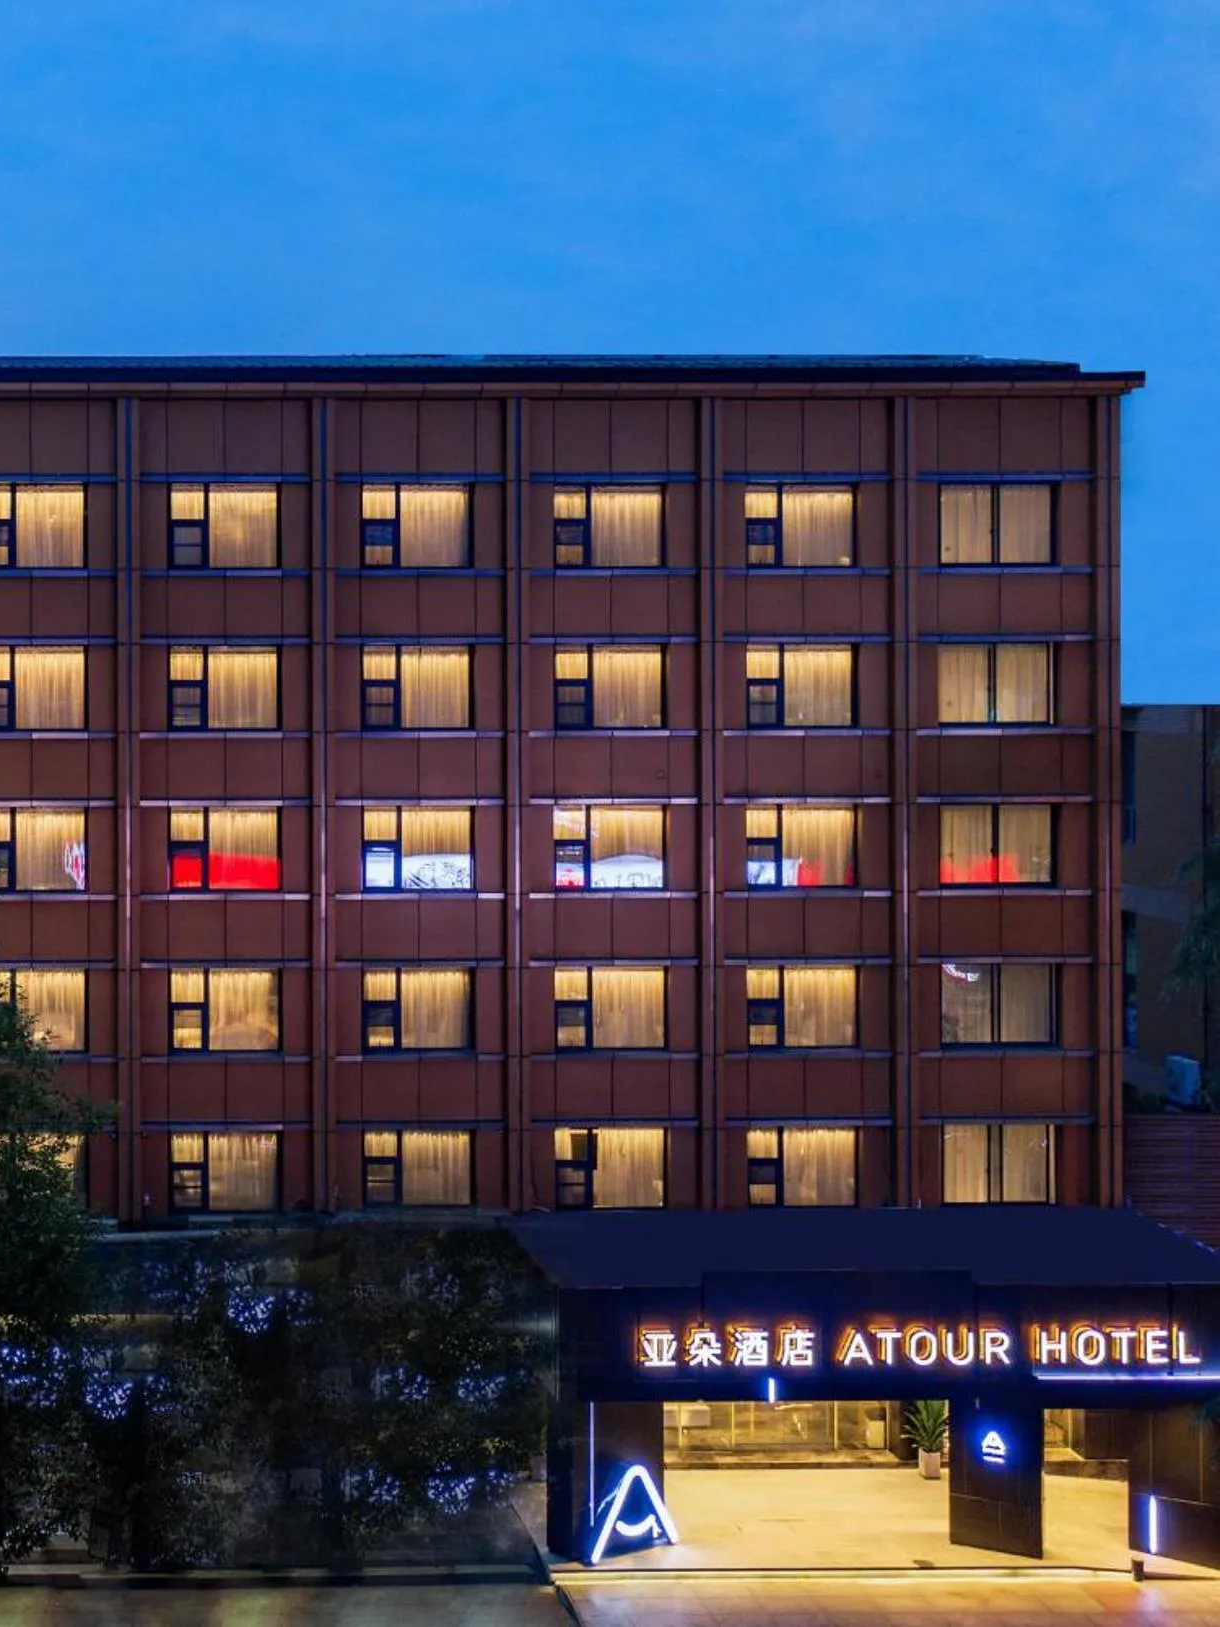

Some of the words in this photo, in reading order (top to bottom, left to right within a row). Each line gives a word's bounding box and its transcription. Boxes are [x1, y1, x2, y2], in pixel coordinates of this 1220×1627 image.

[642, 1326, 816, 1368] 亚朵酒店
[842, 1329, 1012, 1367] ATOUR
[1039, 1329, 1202, 1366] HOTEL
